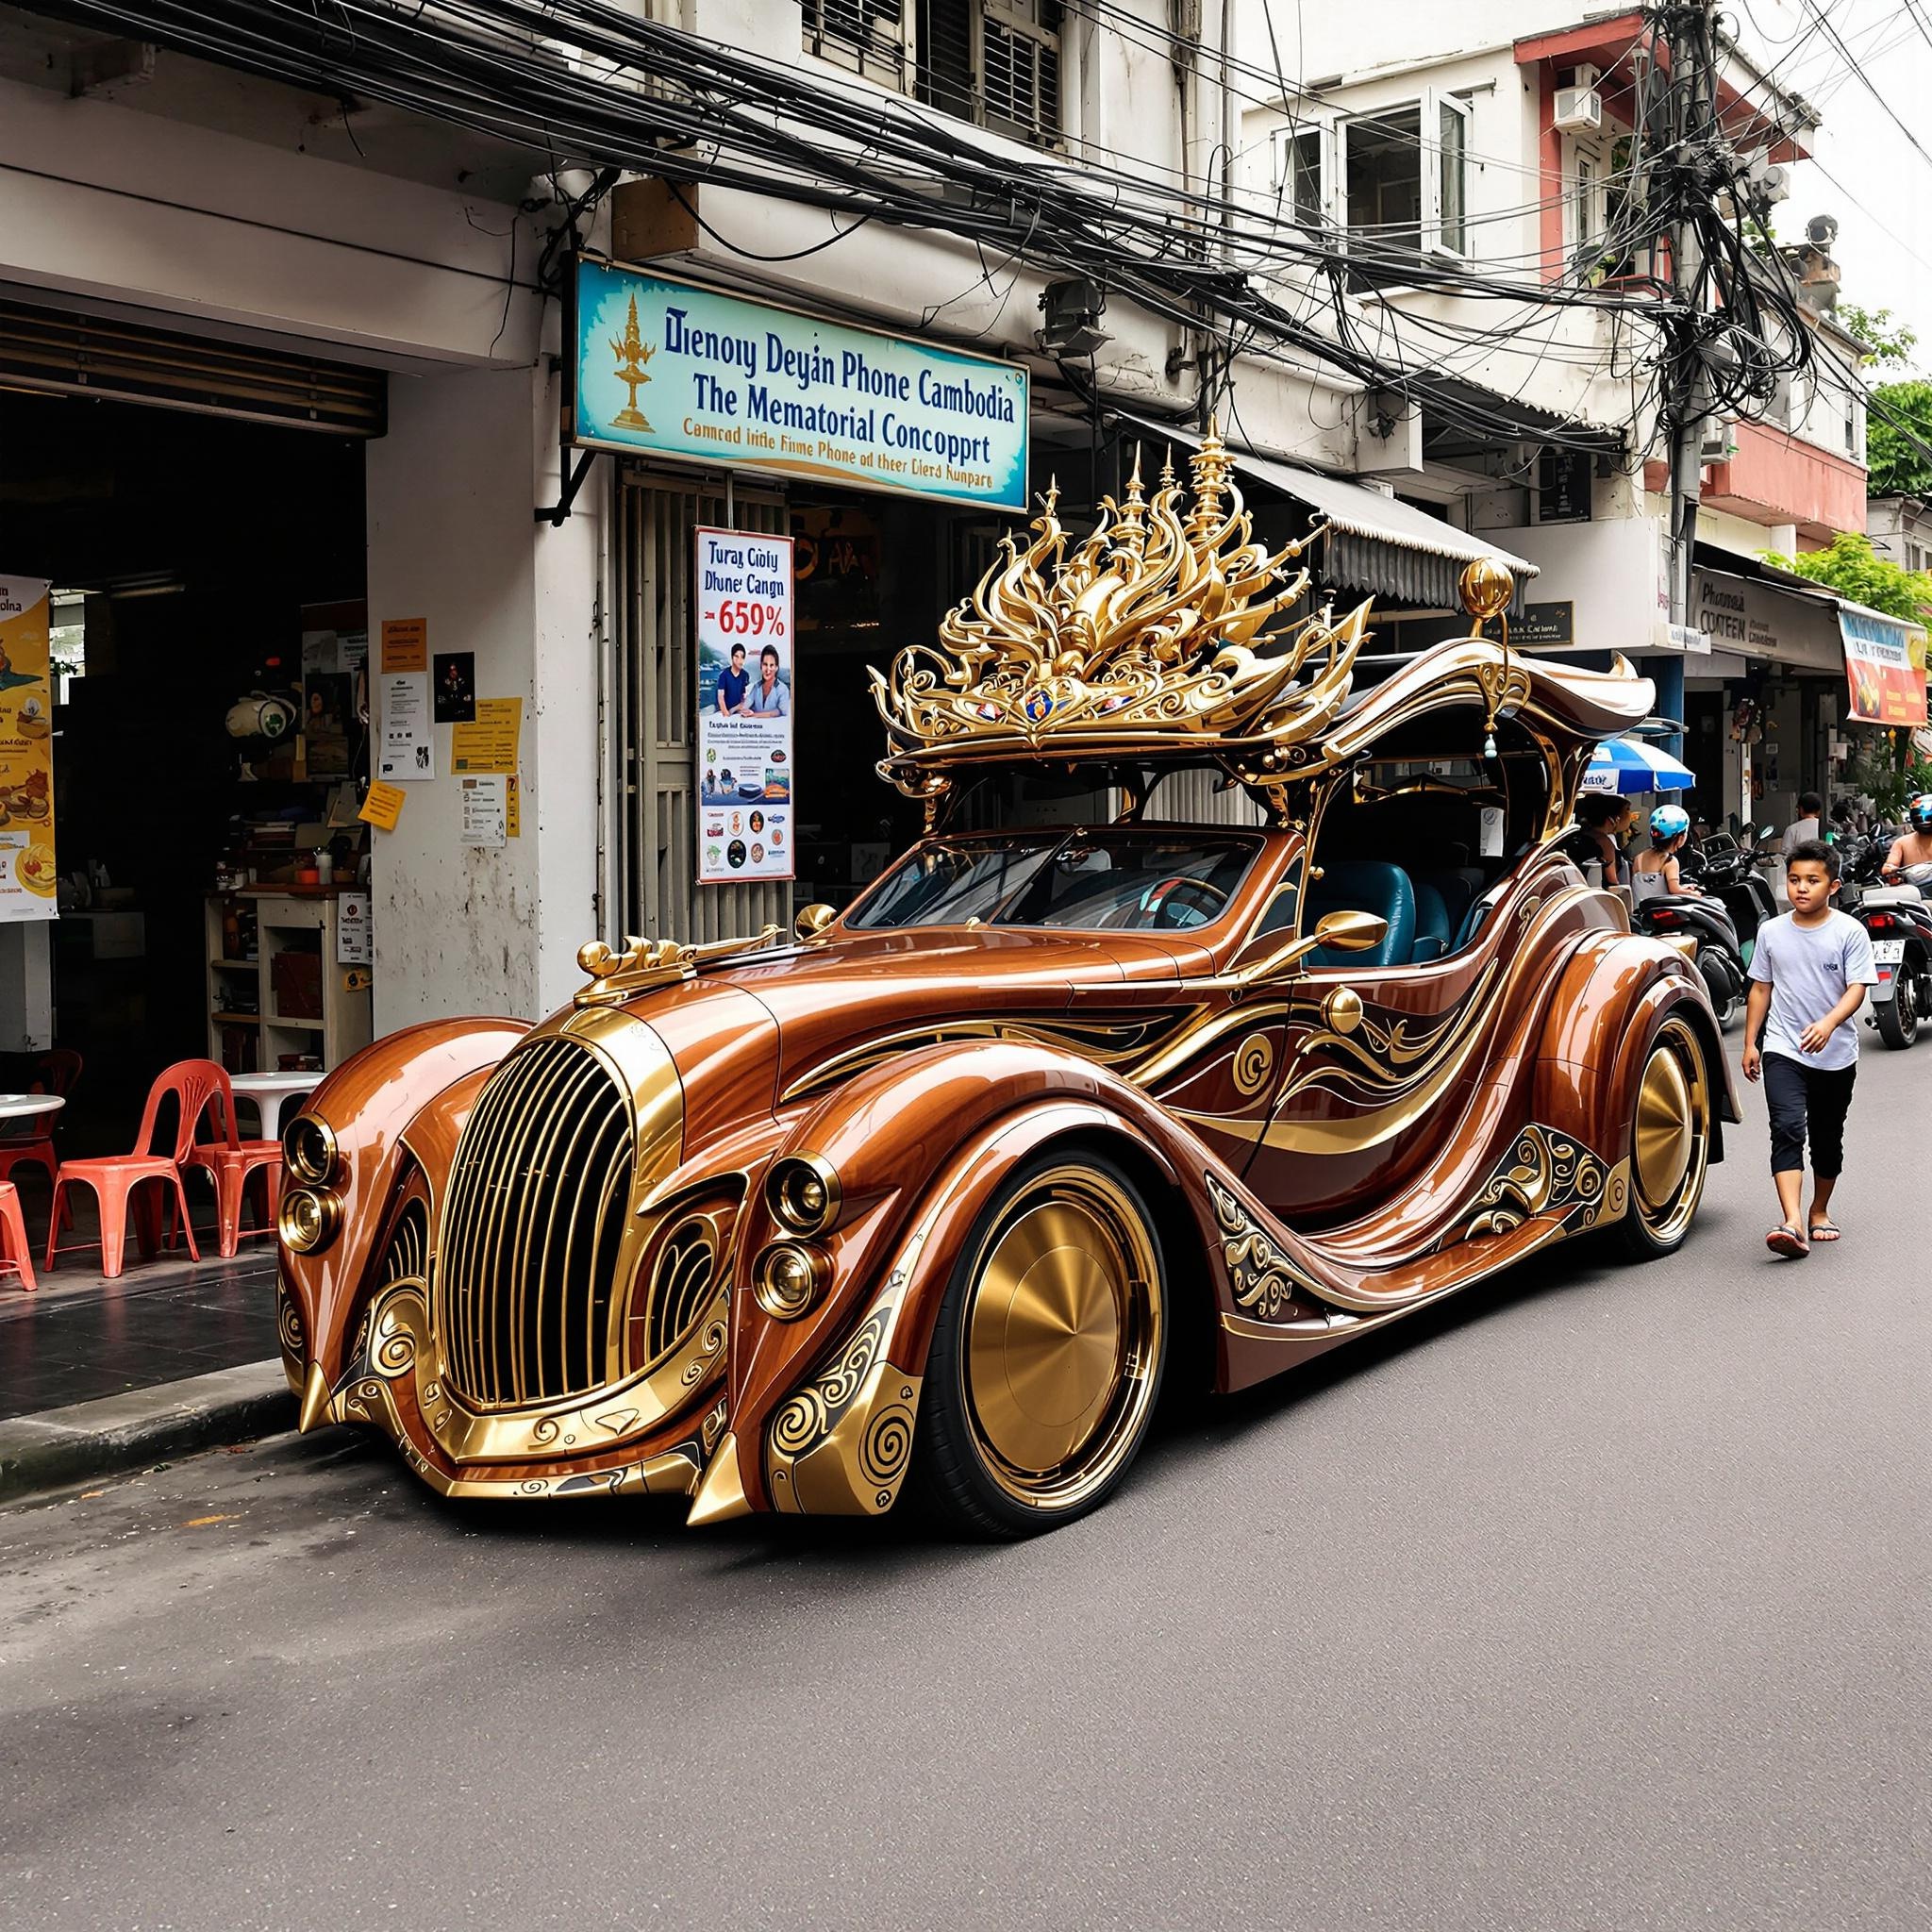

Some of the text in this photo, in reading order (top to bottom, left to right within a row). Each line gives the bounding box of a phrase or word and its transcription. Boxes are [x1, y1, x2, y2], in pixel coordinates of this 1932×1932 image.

[841, 350, 910, 402] Phone
[692, 373, 991, 467] The Mematorial Concopprt
[818, 440, 856, 464] Phone
